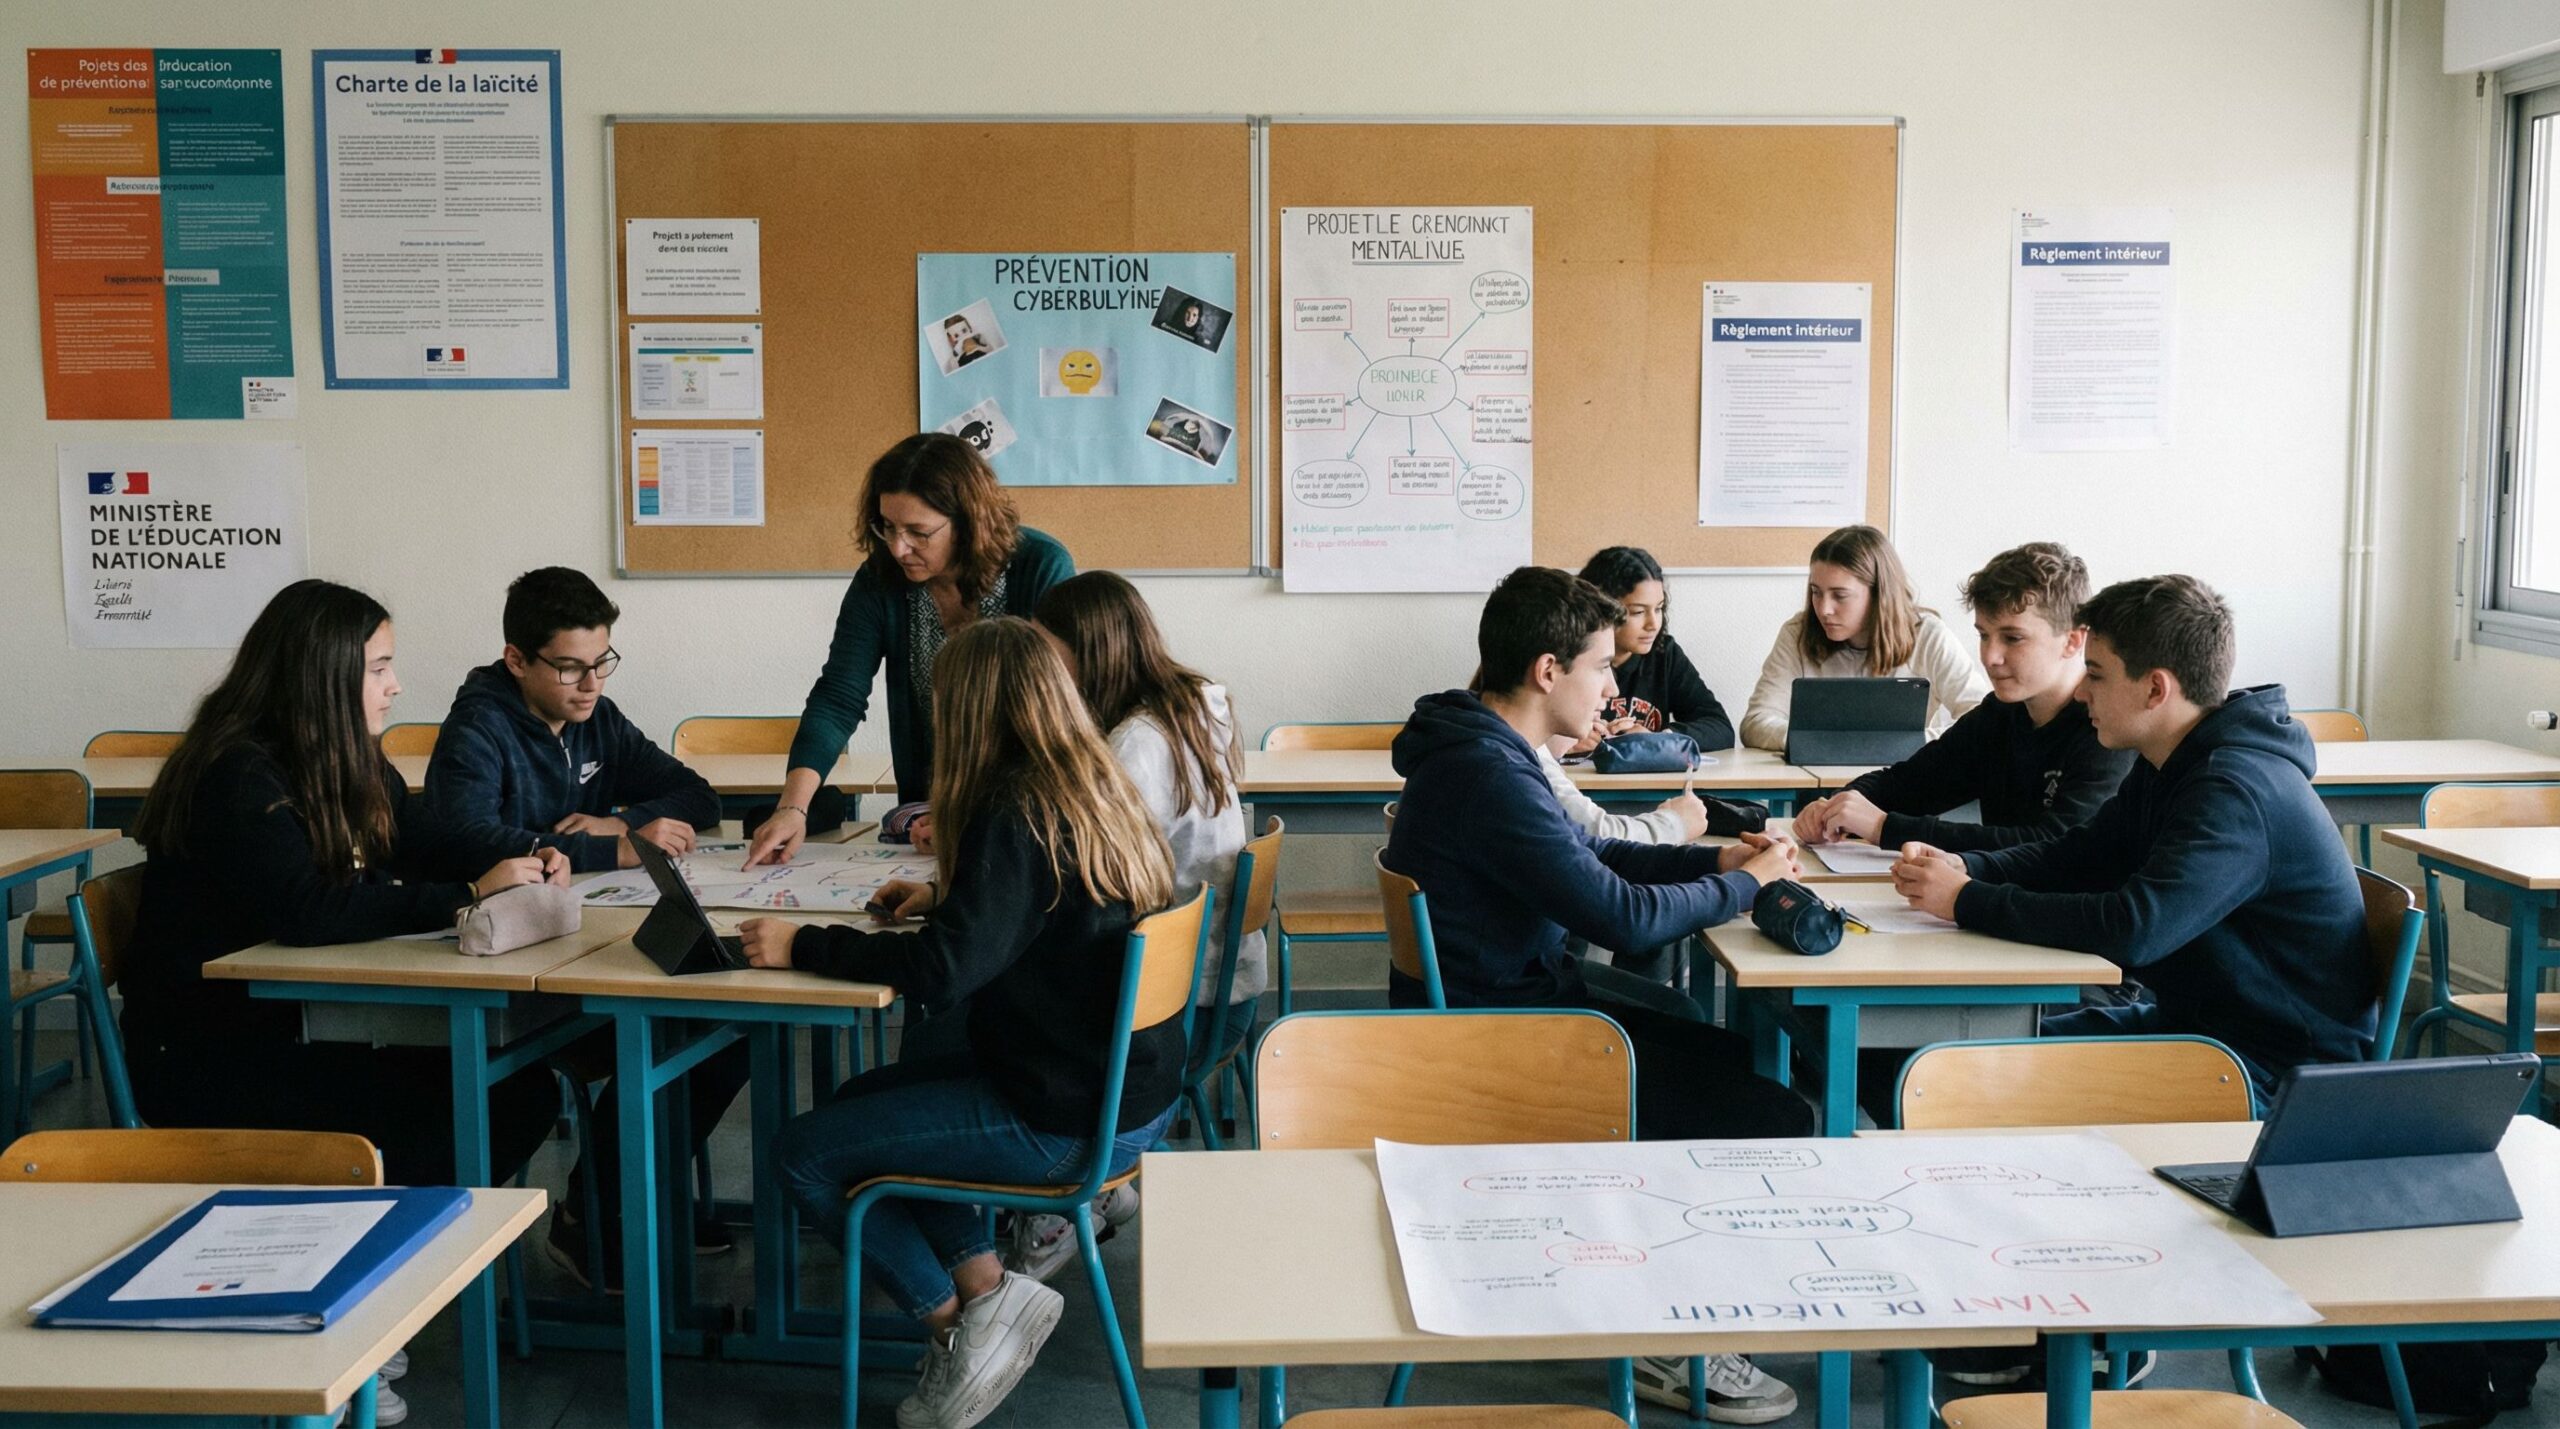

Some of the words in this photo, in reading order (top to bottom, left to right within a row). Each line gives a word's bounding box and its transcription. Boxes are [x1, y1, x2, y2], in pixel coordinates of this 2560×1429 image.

[39, 76, 57, 89] de
[336, 75, 409, 93] Charte
[415, 74, 442, 93] de
[449, 74, 466, 92] la
[473, 74, 538, 93] laïcité
[2030, 247, 2102, 263] Règlement
[2105, 247, 2162, 260] intérieur
[995, 255, 1149, 284] PRÉVENTION
[1720, 323, 1793, 340] Règlement
[1796, 323, 1854, 337] intérieur
[90, 500, 213, 522] MINISTÈRE
[91, 528, 120, 546] DE
[92, 552, 226, 569] NATIONALE
[1871, 1299, 1926, 1316] DE
